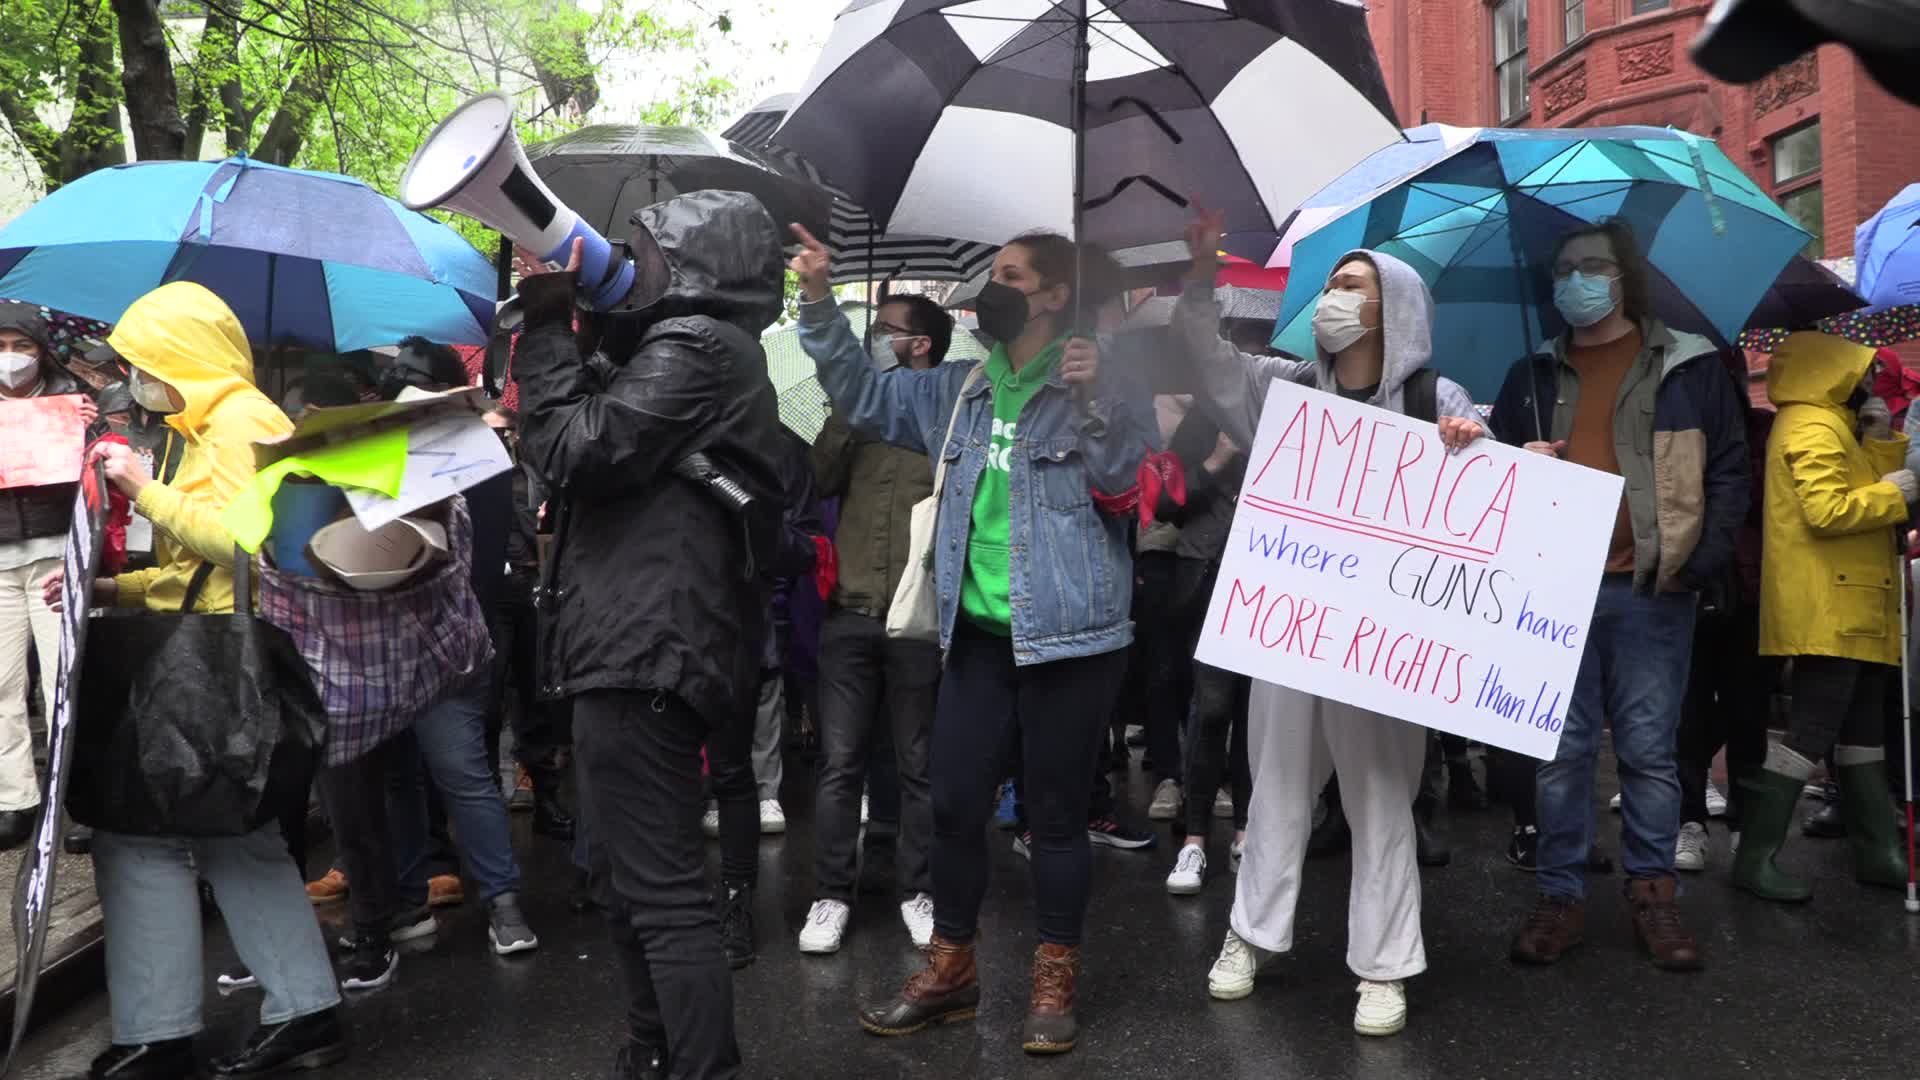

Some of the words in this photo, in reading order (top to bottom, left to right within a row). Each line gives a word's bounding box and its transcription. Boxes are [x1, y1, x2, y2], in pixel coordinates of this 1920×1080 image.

[1252, 400, 1519, 553] AMERICA
[1219, 578, 1342, 661] MORE
[1342, 616, 1473, 704] RIGHTS
[1474, 664, 1526, 724] than
[1249, 524, 1359, 579] where
[1388, 545, 1515, 624] GUNS
[1515, 591, 1579, 649] have
